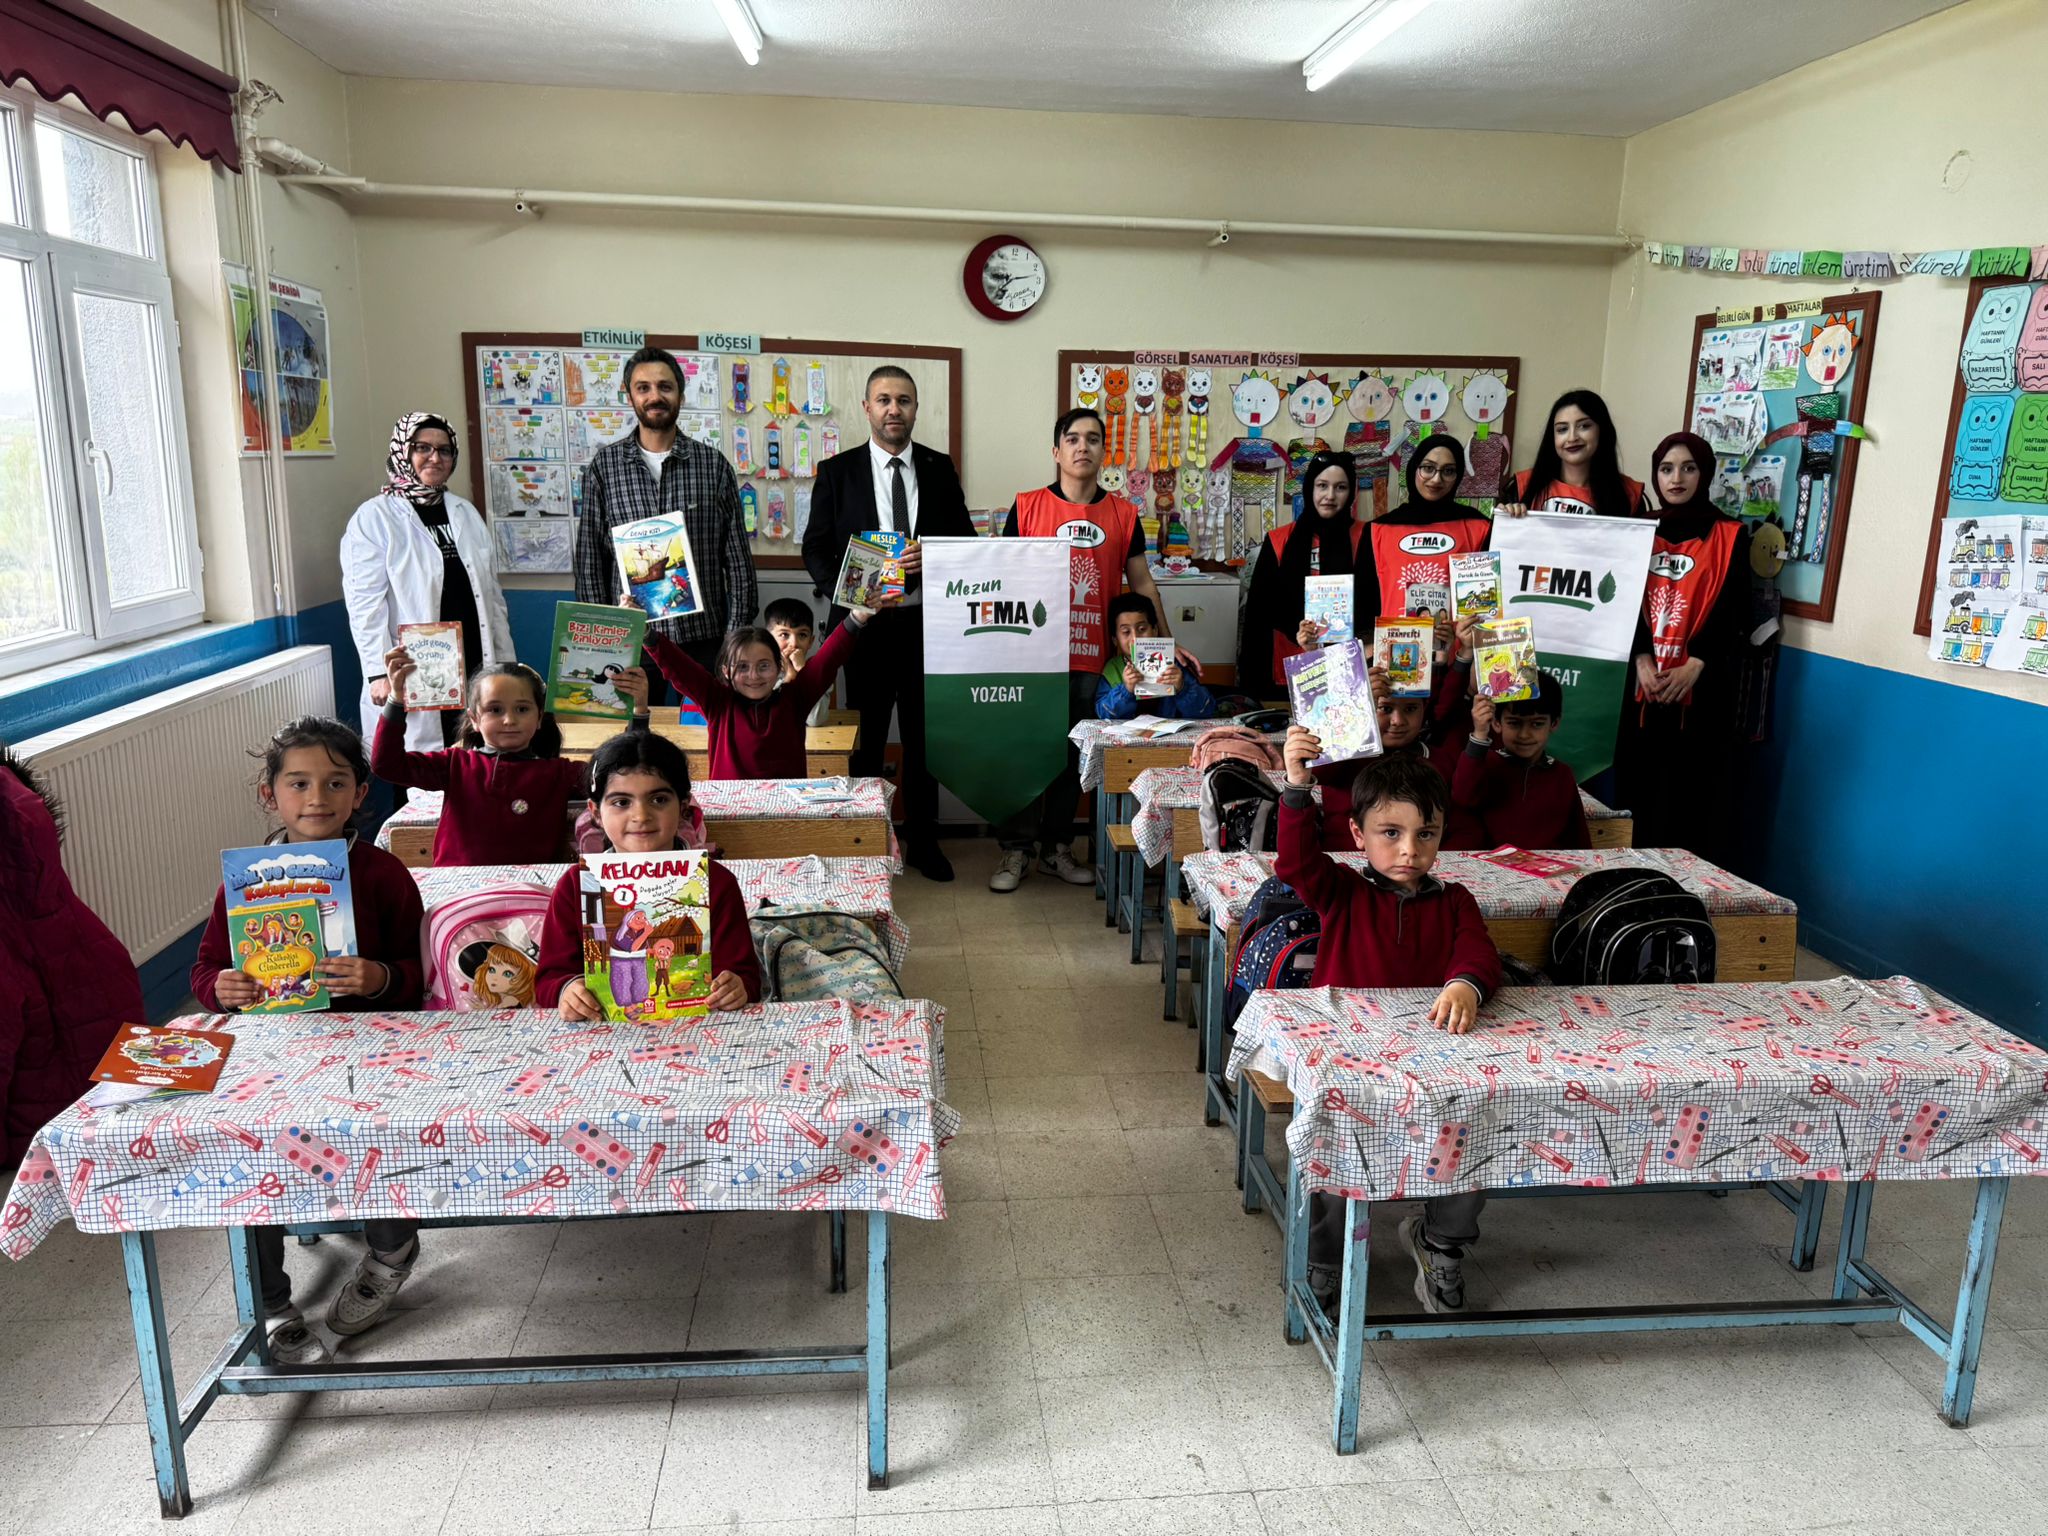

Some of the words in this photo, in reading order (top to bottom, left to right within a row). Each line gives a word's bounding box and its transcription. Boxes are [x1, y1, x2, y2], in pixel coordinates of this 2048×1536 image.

[1769, 250, 1800, 275] tünel
[1844, 255, 1891, 278] üretim
[1911, 251, 1964, 276] kürek
[1977, 248, 2021, 277] kütük
[1717, 311, 1736, 323] BELİRLİ
[1737, 310, 1750, 322] GÜN
[1766, 307, 1776, 317] VE
[1787, 301, 1822, 314] HAFTALAR
[584, 330, 644, 346] ETKİNLİK
[706, 334, 752, 350] KÖŞESİ
[1136, 351, 1178, 364] GÖRSEL
[1190, 354, 1249, 365] SANATLAR
[1260, 352, 1299, 366] KÖŞESİ
[1554, 501, 1584, 515] TEMA
[870, 534, 898, 544] MESLEK
[1067, 526, 1092, 538] TEMA
[1411, 536, 1438, 546] TEMA
[946, 579, 1002, 598] Mezun
[1518, 564, 1592, 598] TEMA
[1410, 588, 1426, 598] ELİF
[1428, 590, 1447, 599] GİTAR
[1414, 598, 1446, 608] ÇALIYOR
[966, 601, 1029, 625] TEMA
[594, 625, 629, 636] Kimler
[573, 634, 621, 646] Dinliyor?
[970, 686, 1024, 703] YOZGAT
[601, 860, 689, 880] KELOĞLAN
[620, 890, 628, 902] 1
[258, 960, 300, 972] Cinderella
